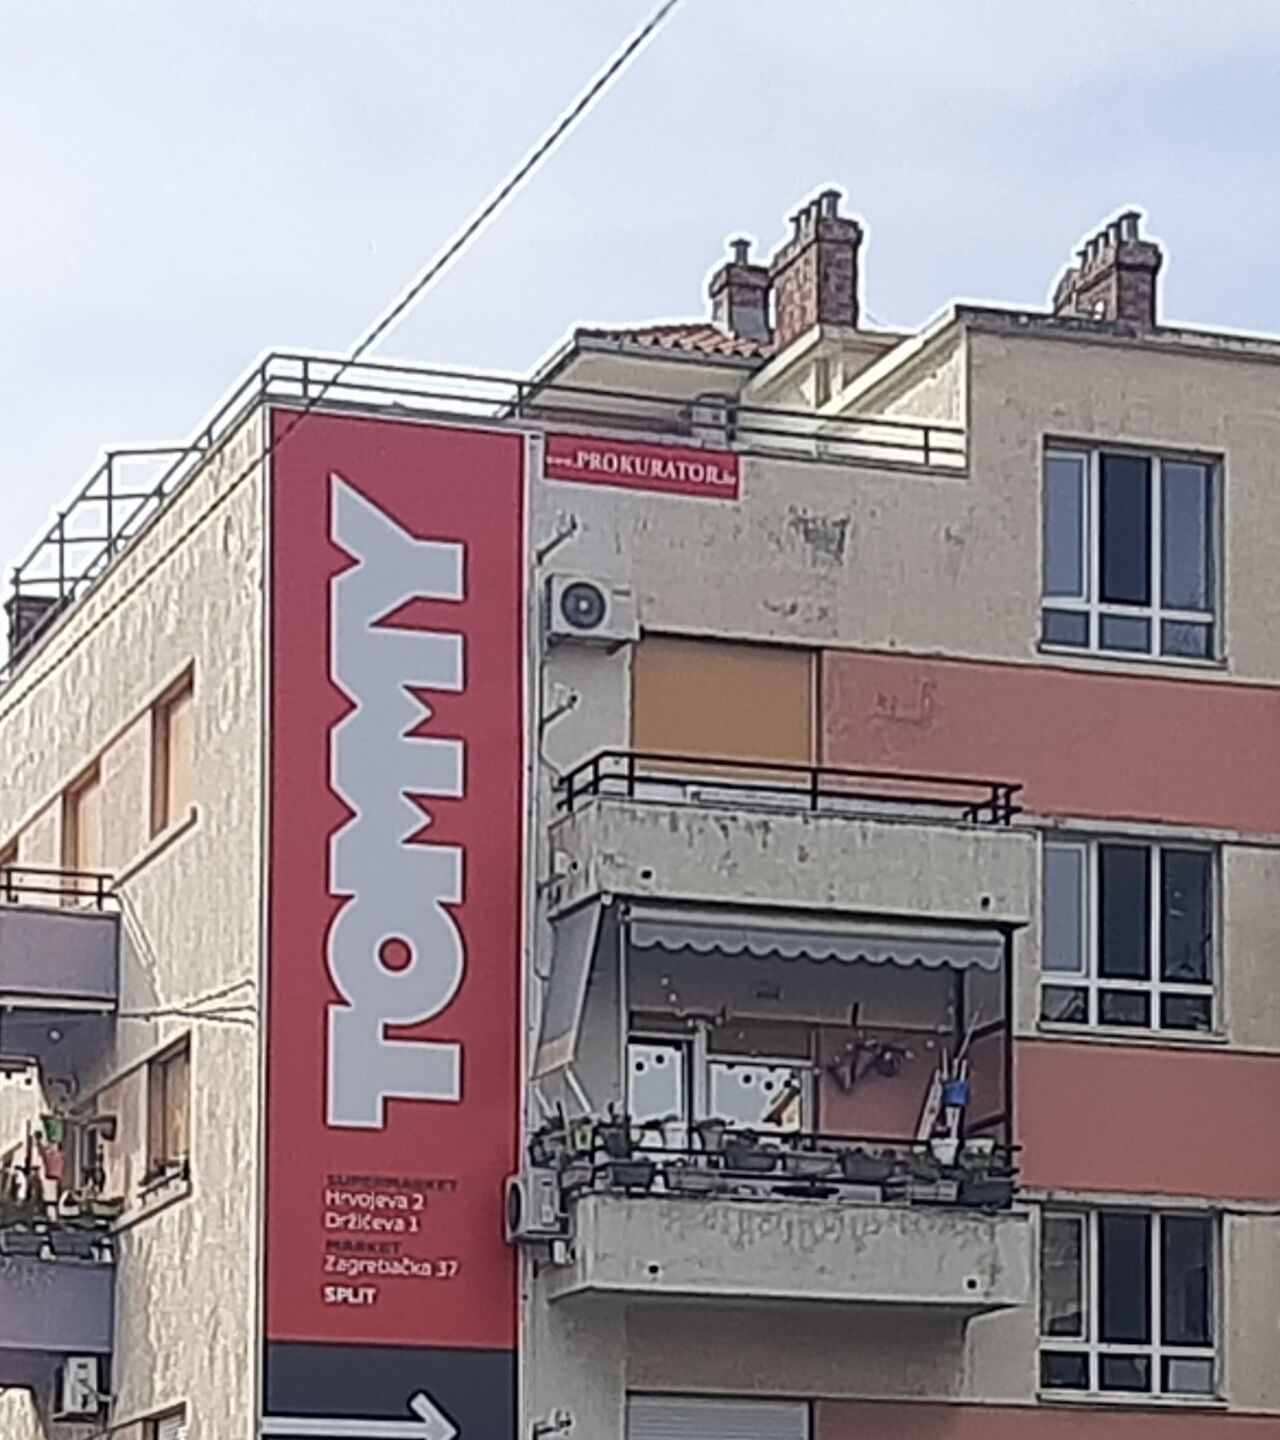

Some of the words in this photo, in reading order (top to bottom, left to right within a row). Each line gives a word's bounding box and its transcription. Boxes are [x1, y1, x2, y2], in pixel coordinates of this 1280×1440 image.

[326, 472, 466, 1129] TOMMY
[412, 1193, 425, 1210] 2
[436, 1260, 458, 1277] 37
[324, 1286, 377, 1304] SPLIT
